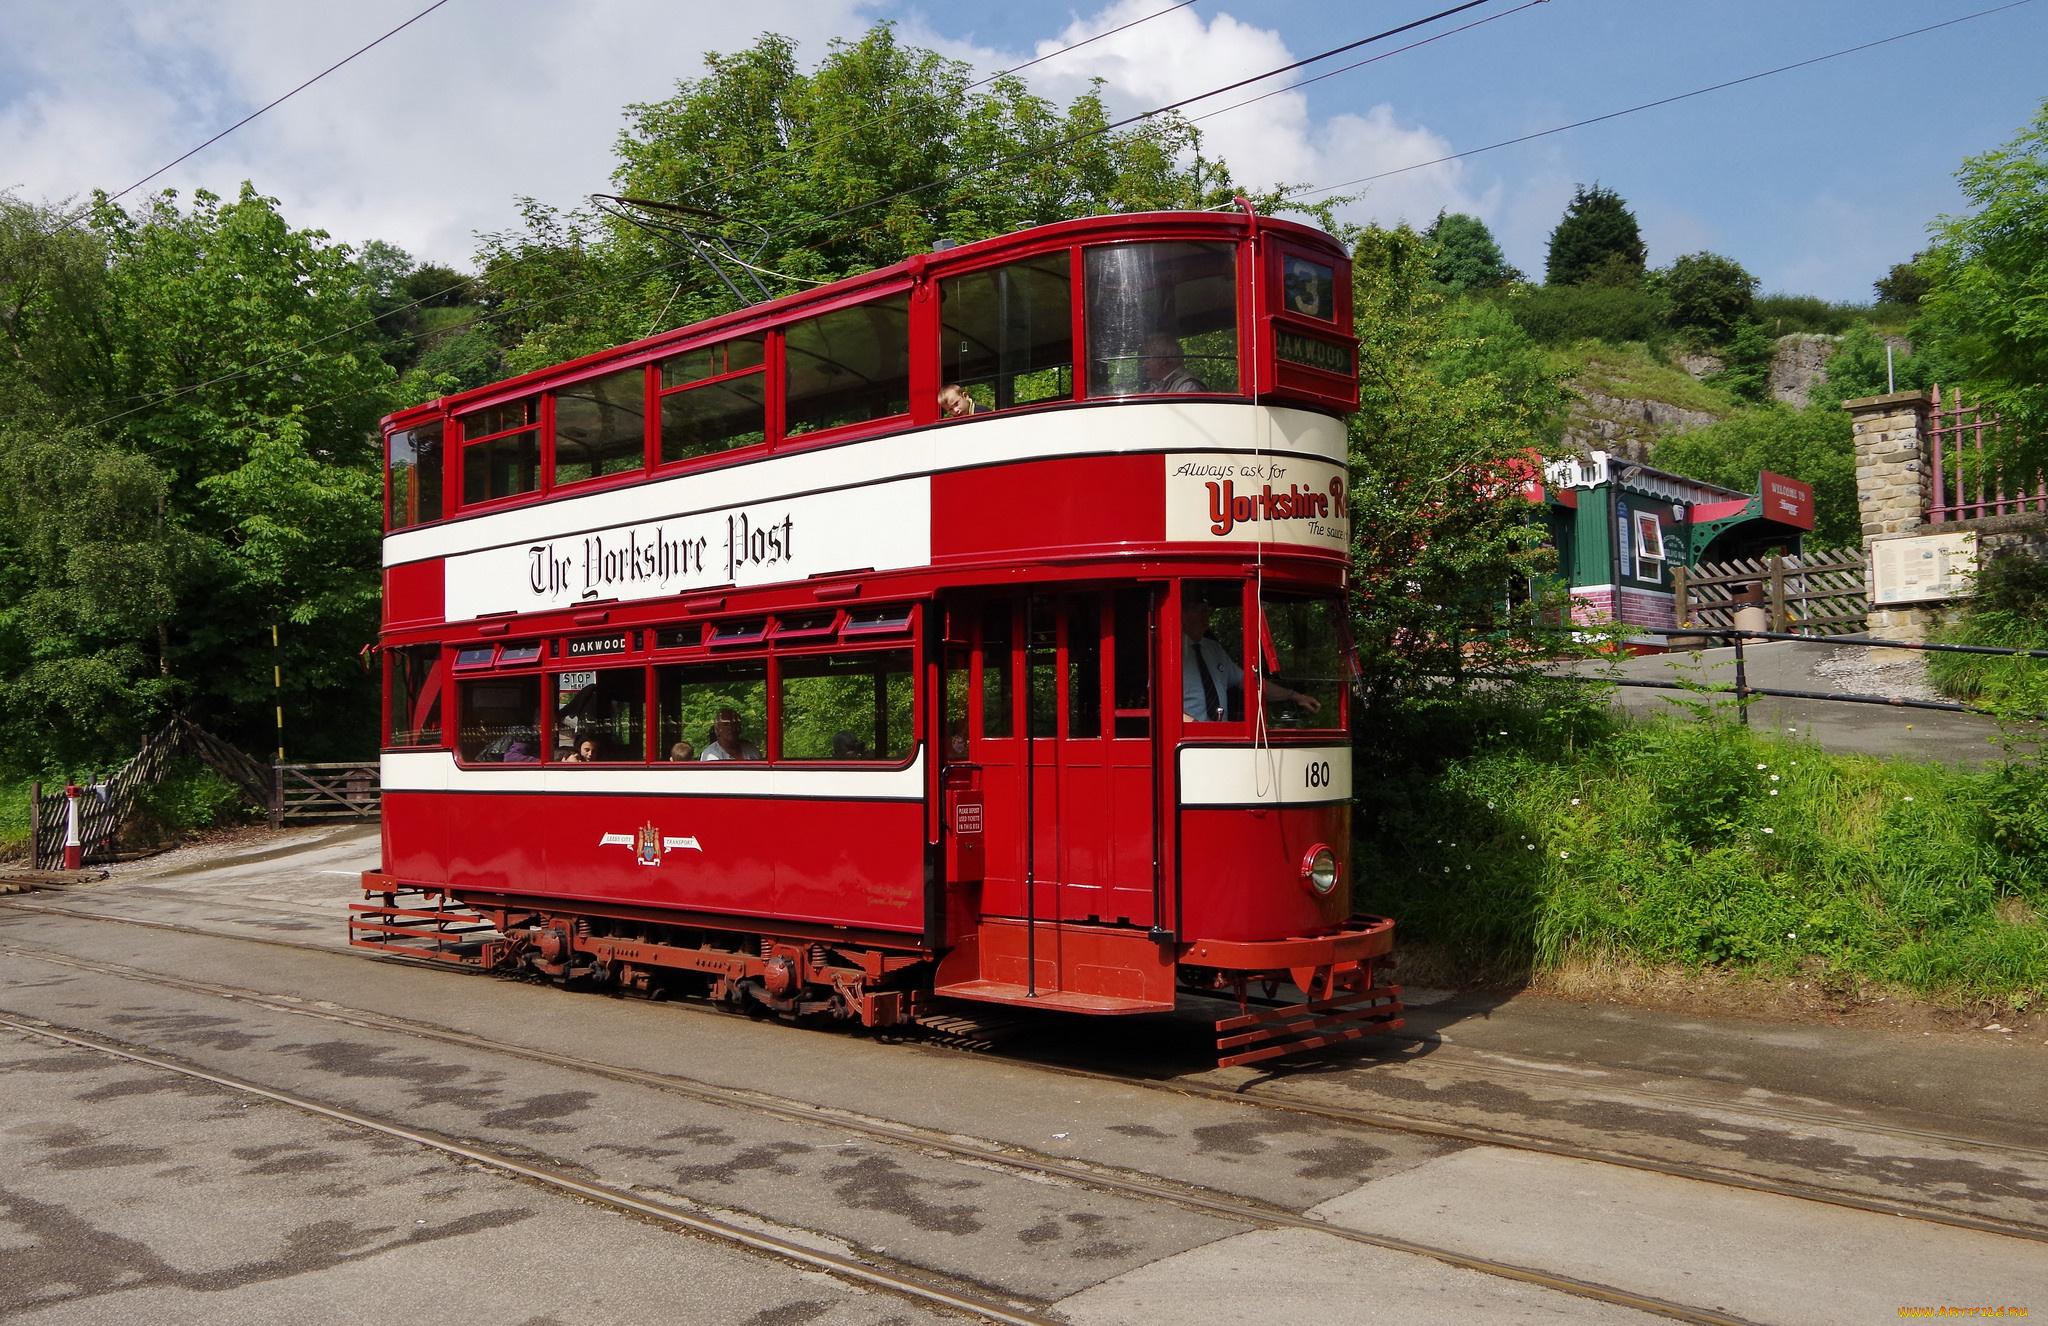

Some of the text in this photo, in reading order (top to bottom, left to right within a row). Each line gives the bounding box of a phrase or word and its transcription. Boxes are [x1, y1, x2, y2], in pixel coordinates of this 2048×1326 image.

[1293, 261, 1319, 315] 3
[1172, 462, 1287, 481] Always ask for
[1771, 482, 1798, 499] WELCOME
[1204, 479, 1329, 536] Yorkshire
[1308, 521, 1344, 541] The sauce
[528, 511, 794, 602] The Yorkshire Post
[572, 638, 626, 653] OAKWOOD
[563, 673, 591, 683] STOP
[1305, 761, 1330, 788] 180
[958, 807, 969, 815] PLEASE
